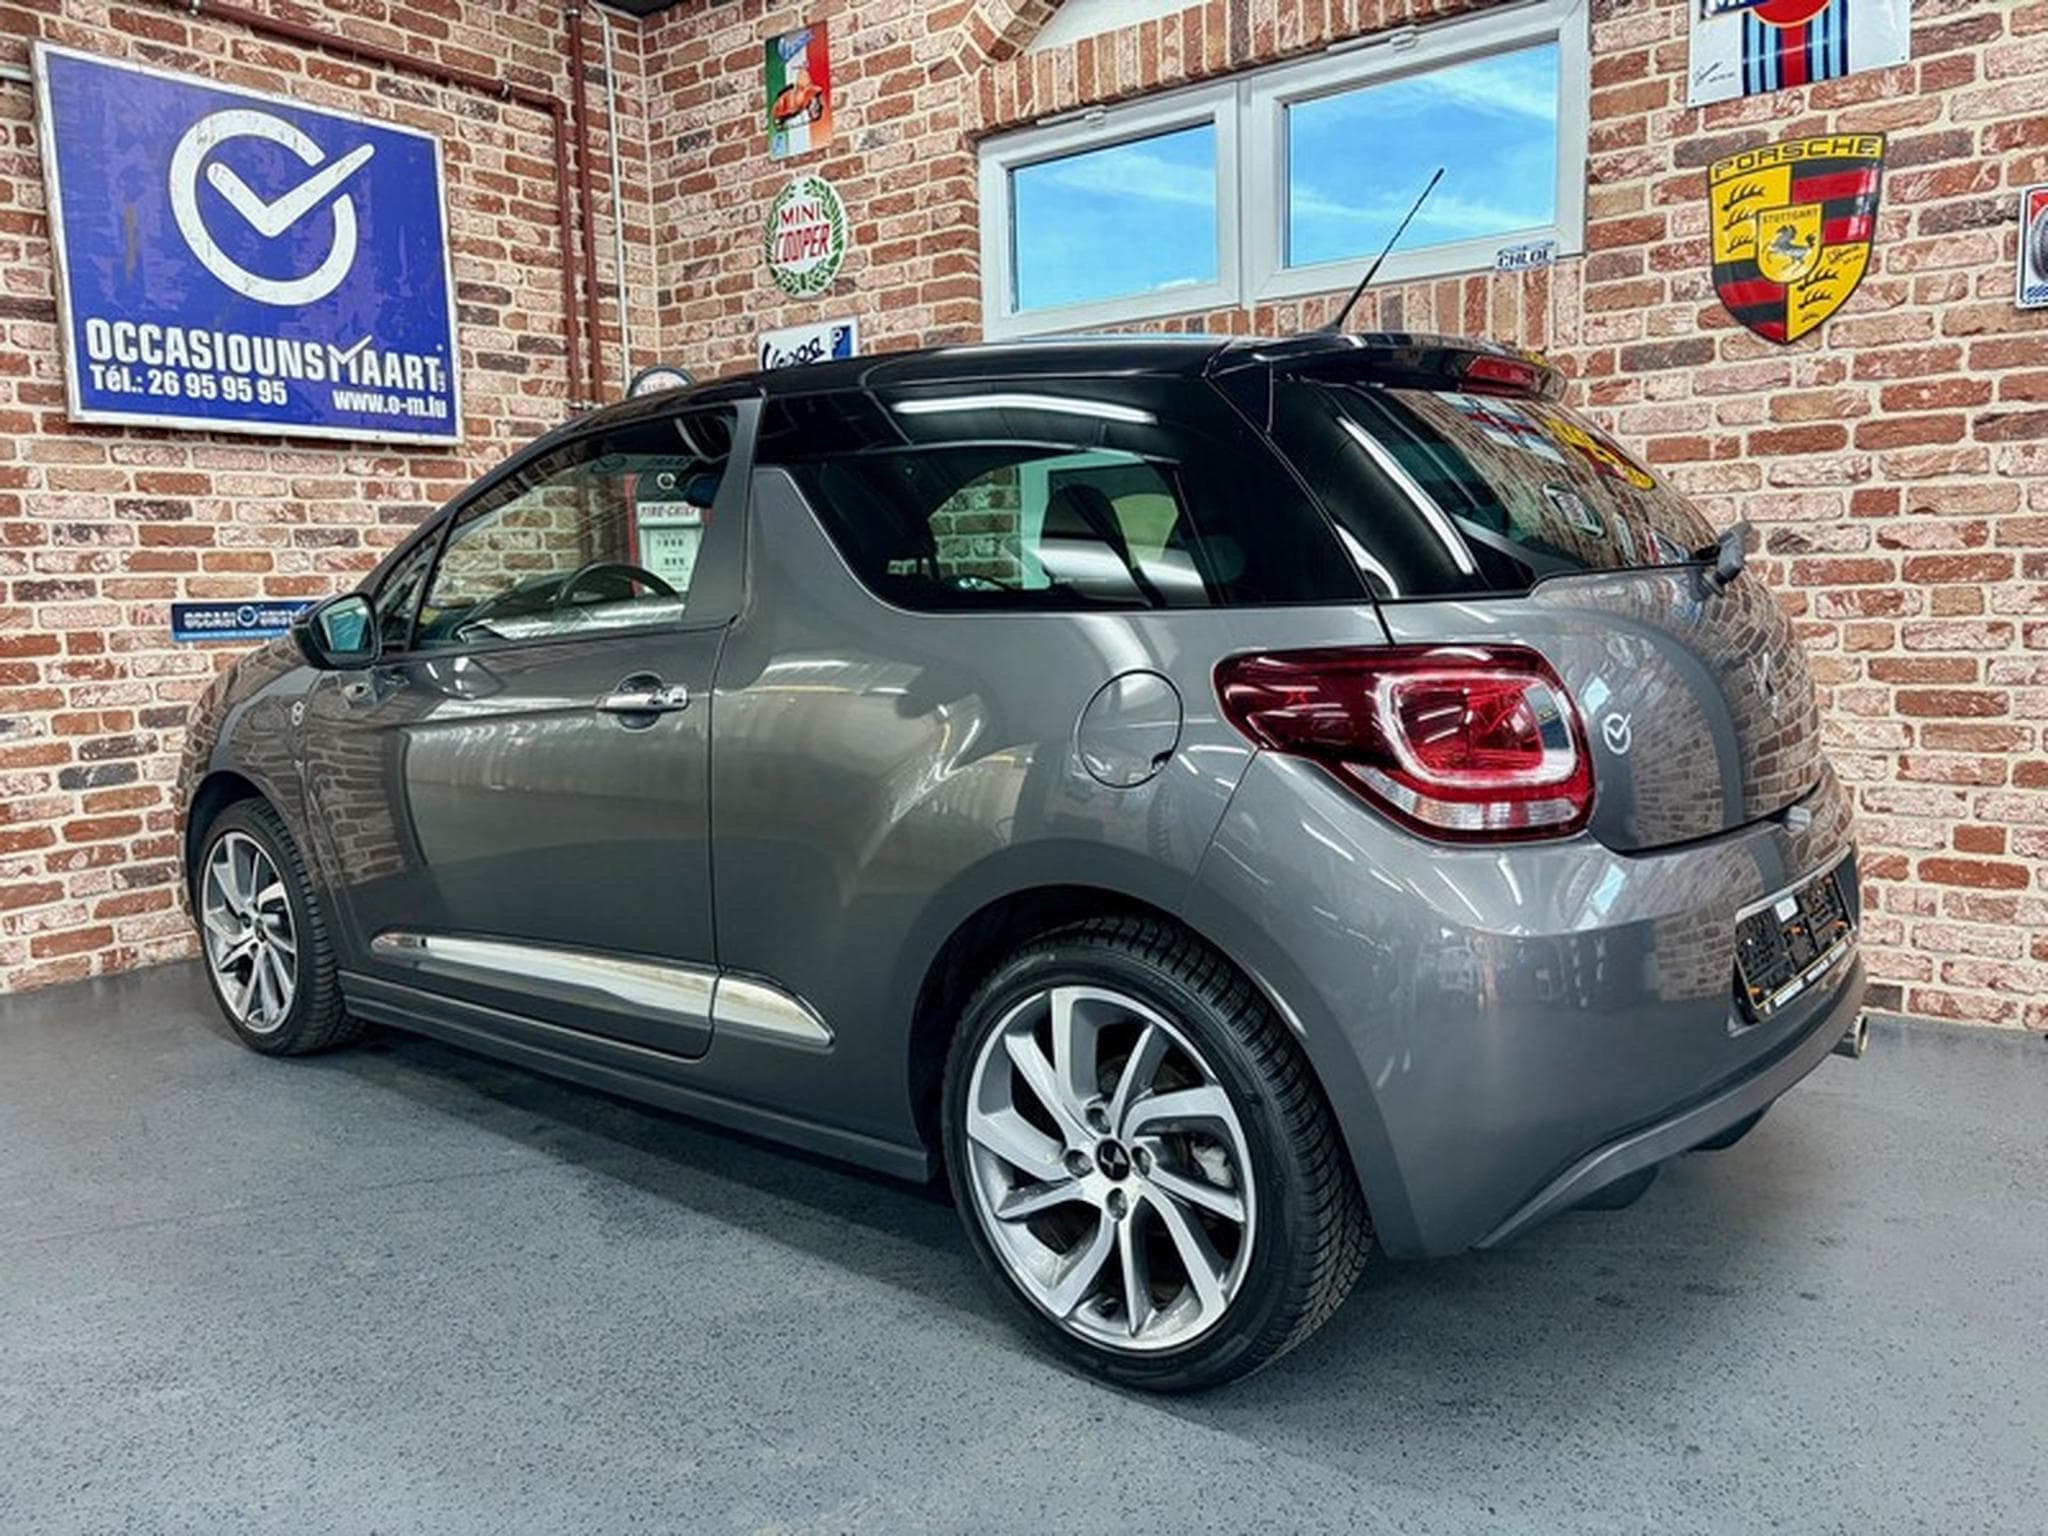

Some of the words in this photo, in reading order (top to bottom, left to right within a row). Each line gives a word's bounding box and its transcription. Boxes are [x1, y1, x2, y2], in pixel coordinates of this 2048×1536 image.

[1714, 138, 1880, 180] PORSCHE
[780, 203, 821, 226] MINI
[774, 224, 831, 265] COOPER
[148, 369, 181, 397] 26
[184, 371, 218, 400] 95
[221, 375, 253, 403] 95
[256, 379, 289, 405] 95
[332, 389, 448, 419] www.o-m.lu
